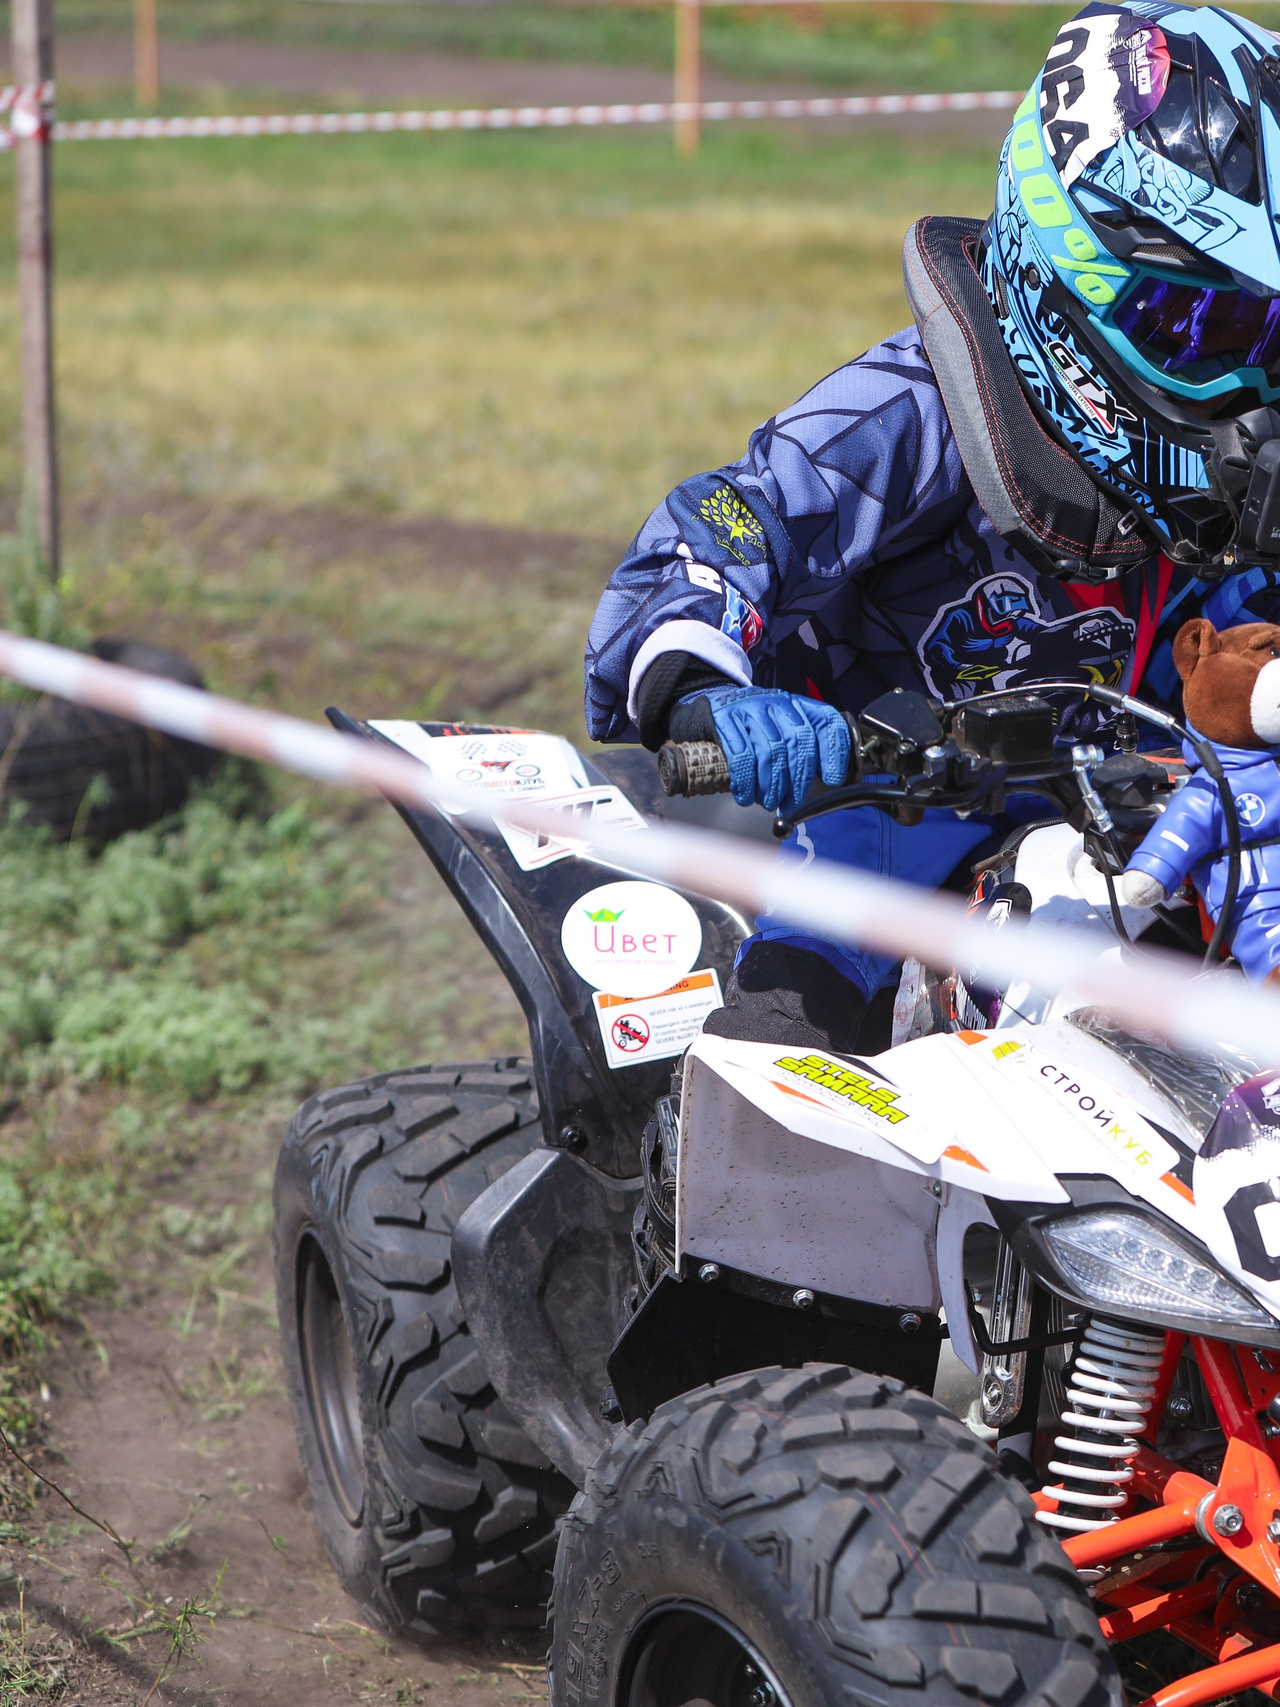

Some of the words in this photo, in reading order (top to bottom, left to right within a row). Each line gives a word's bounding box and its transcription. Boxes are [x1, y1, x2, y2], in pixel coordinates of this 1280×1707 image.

[1046, 340, 1138, 429] GTX
[594, 925, 677, 953] Цвет
[772, 1056, 910, 1125] SAMARA
[799, 1054, 902, 1104] STELS
[1040, 1065, 1154, 1166] СТРОЙКУБ
